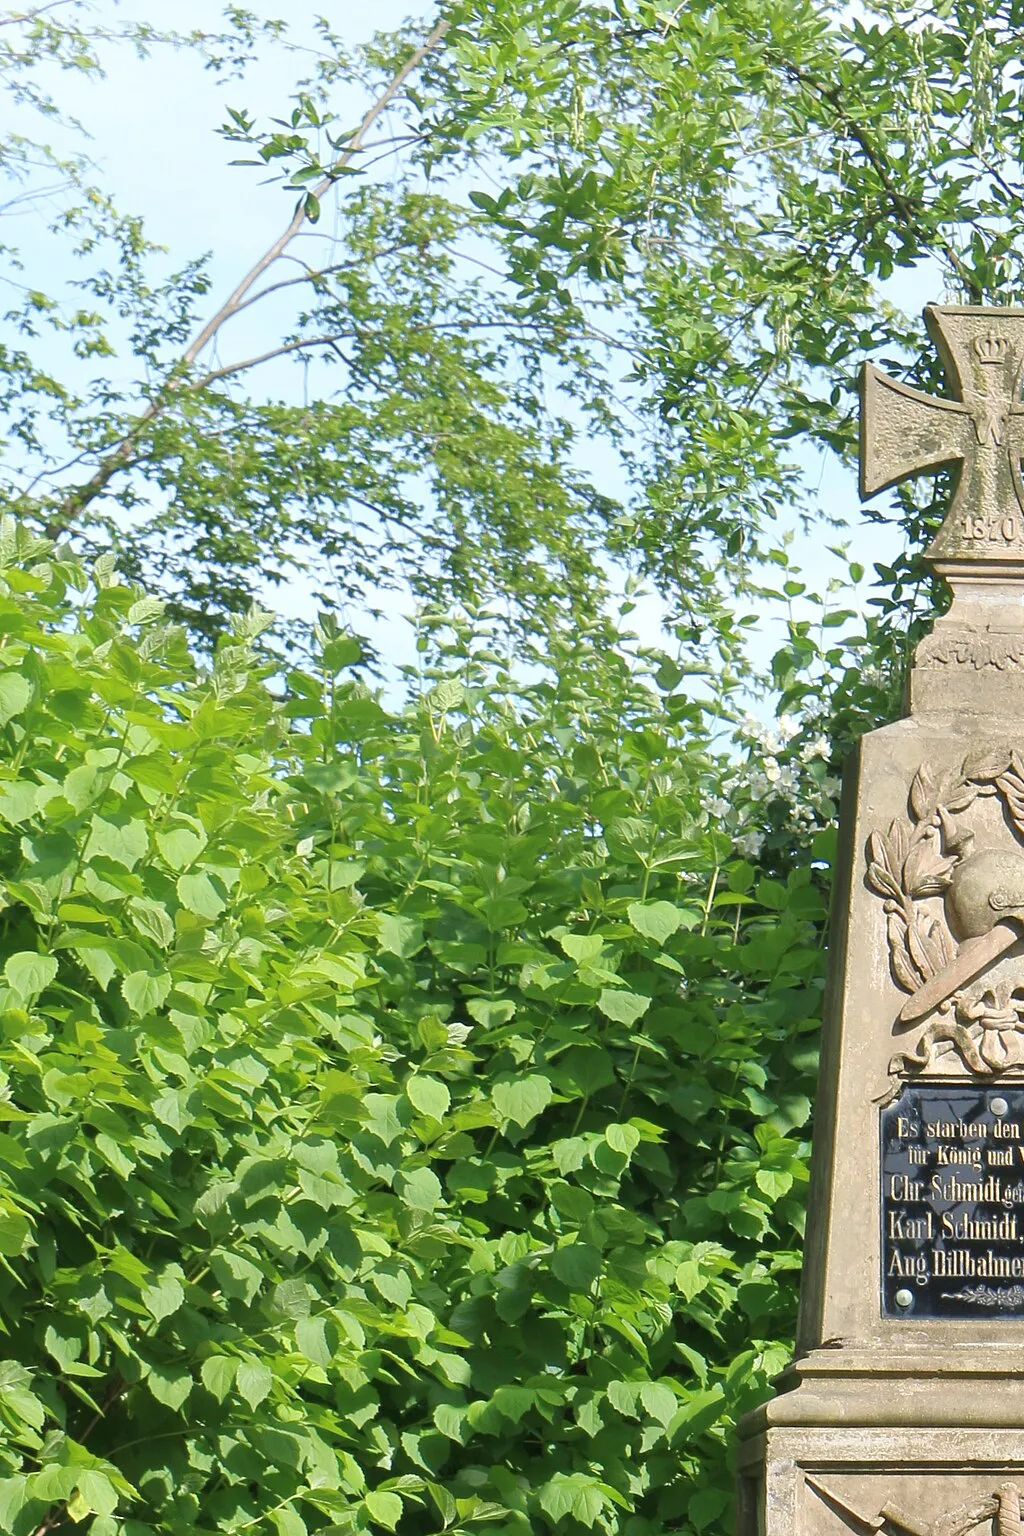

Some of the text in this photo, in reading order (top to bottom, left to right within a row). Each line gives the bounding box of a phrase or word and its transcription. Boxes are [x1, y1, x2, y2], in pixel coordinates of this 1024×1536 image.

[961, 515, 1017, 541] 1870
[897, 1117, 919, 1138] Es
[926, 1118, 988, 1138] starben
[993, 1119, 1020, 1139] den
[908, 1144, 930, 1165] für
[936, 1145, 983, 1172] König
[987, 1146, 1014, 1167] und
[890, 1173, 927, 1202] Chr.
[888, 1211, 934, 1240] Karl
[941, 1211, 1024, 1244] Schmidt,
[887, 1248, 930, 1286] Aug.
